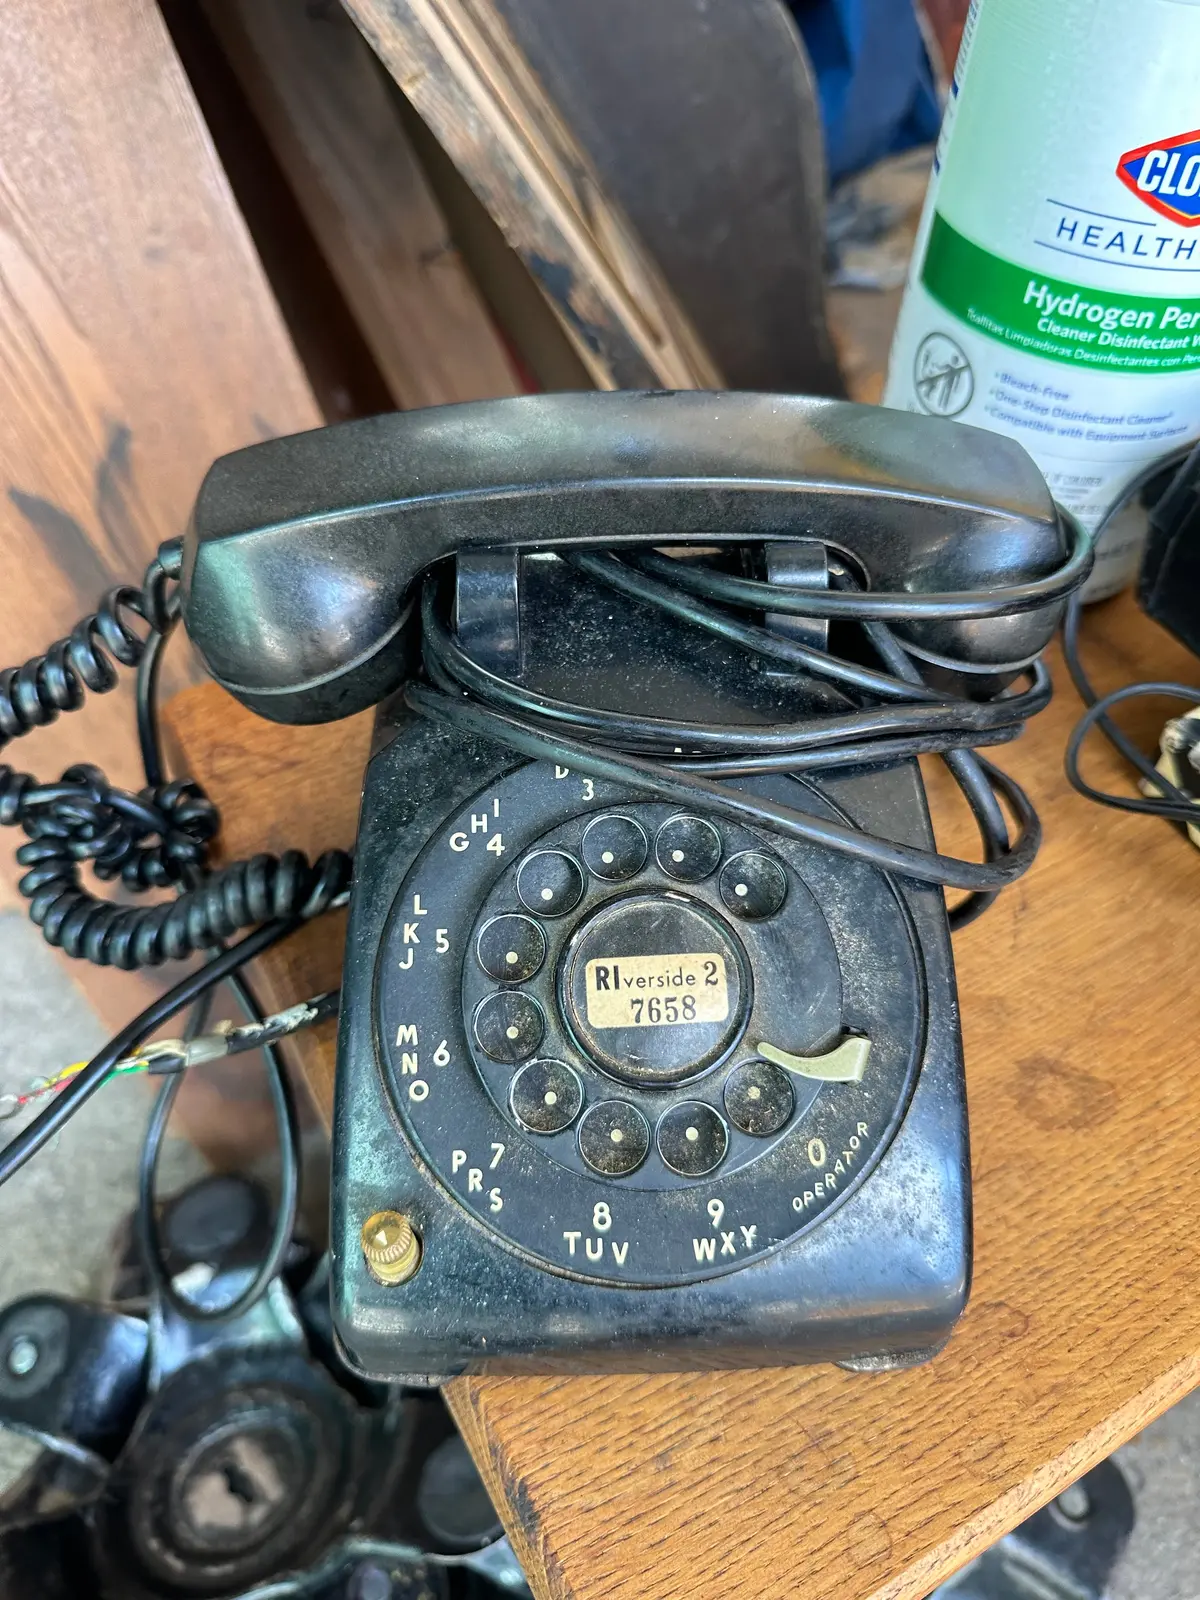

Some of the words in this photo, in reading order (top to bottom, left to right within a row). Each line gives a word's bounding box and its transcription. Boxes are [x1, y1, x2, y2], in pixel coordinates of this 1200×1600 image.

[1057, 217, 1197, 260] HEALTH
[1022, 280, 1155, 330] Hydrogen
[1037, 317, 1097, 343] Cleaner
[1098, 331, 1190, 350] Disinfectant
[1074, 349, 1159, 367] Desinfectantes
[582, 779, 594, 801] 3
[486, 833, 506, 857] 4
[435, 928, 450, 954] 5
[595, 965, 696, 991] RIverside
[703, 961, 719, 986] 2
[630, 994, 696, 1024] 7658
[433, 1039, 451, 1067] 6
[489, 1143, 505, 1170] 7
[792, 1122, 869, 1212] OPERATOR
[593, 1201, 612, 1232] 8
[707, 1198, 725, 1227] 9
